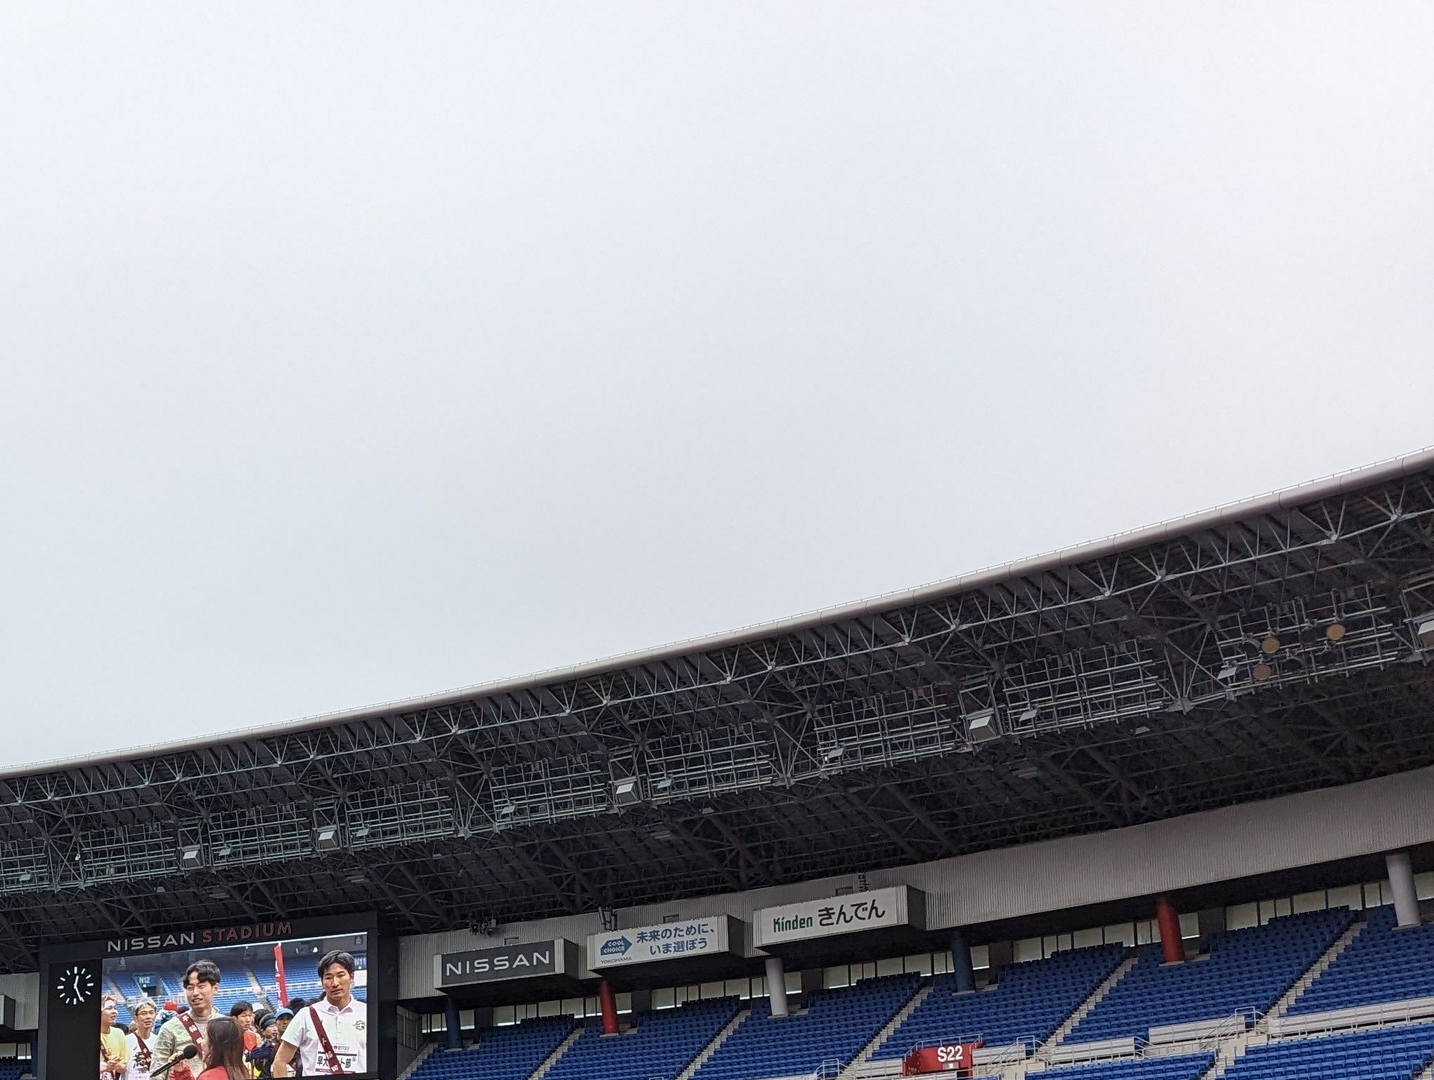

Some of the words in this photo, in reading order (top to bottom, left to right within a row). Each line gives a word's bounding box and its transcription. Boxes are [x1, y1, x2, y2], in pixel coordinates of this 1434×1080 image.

[772, 913, 814, 934] Kinden
[817, 899, 886, 928] きんでん
[107, 931, 195, 953] NISSAN
[201, 920, 294, 944] STADIUM
[636, 923, 715, 944] 未来のために、
[649, 937, 708, 956] いま選ぼう
[446, 949, 551, 975] NISSAN
[600, 956, 633, 965] YOKOHAMA
[937, 1045, 964, 1063] S22
